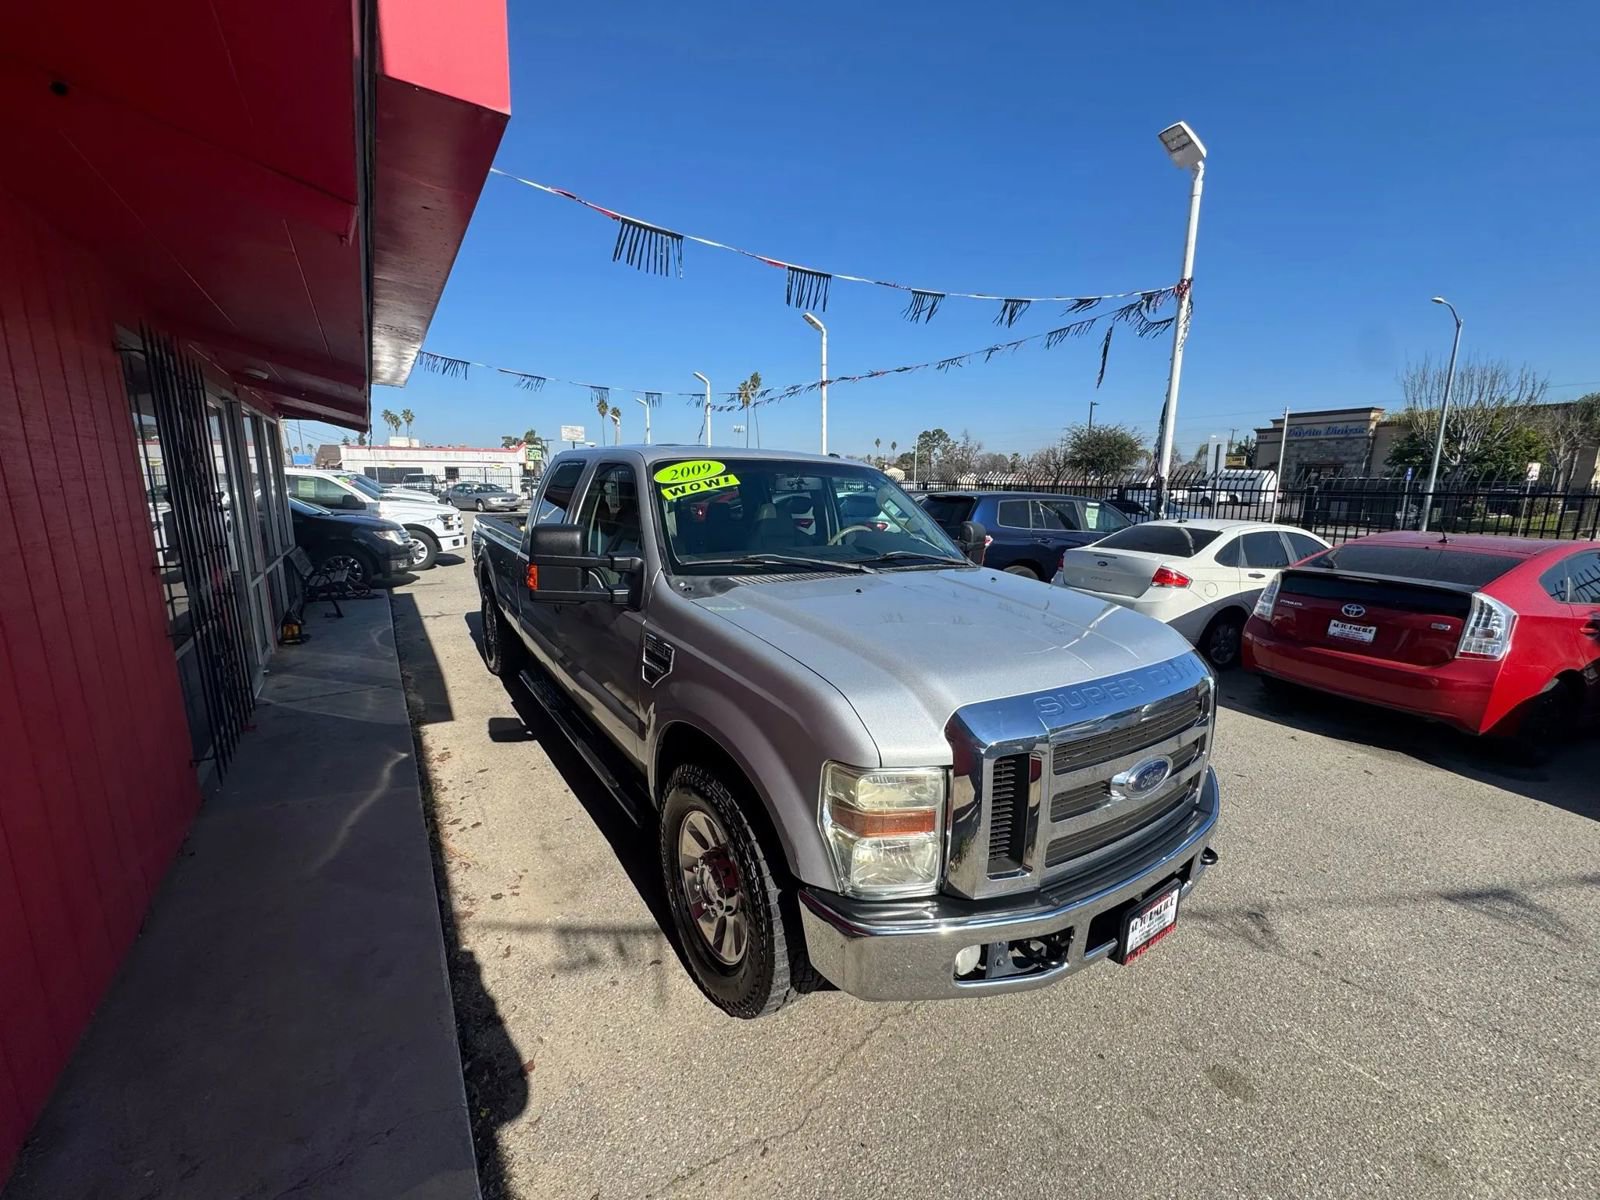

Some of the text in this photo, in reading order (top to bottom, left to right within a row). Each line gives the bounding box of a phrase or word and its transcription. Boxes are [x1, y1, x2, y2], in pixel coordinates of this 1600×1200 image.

[670, 463, 712, 481] 2009
[668, 476, 730, 497] WOW!
[1033, 677, 1145, 717] SUPER
[1140, 768, 1164, 789] Ford
